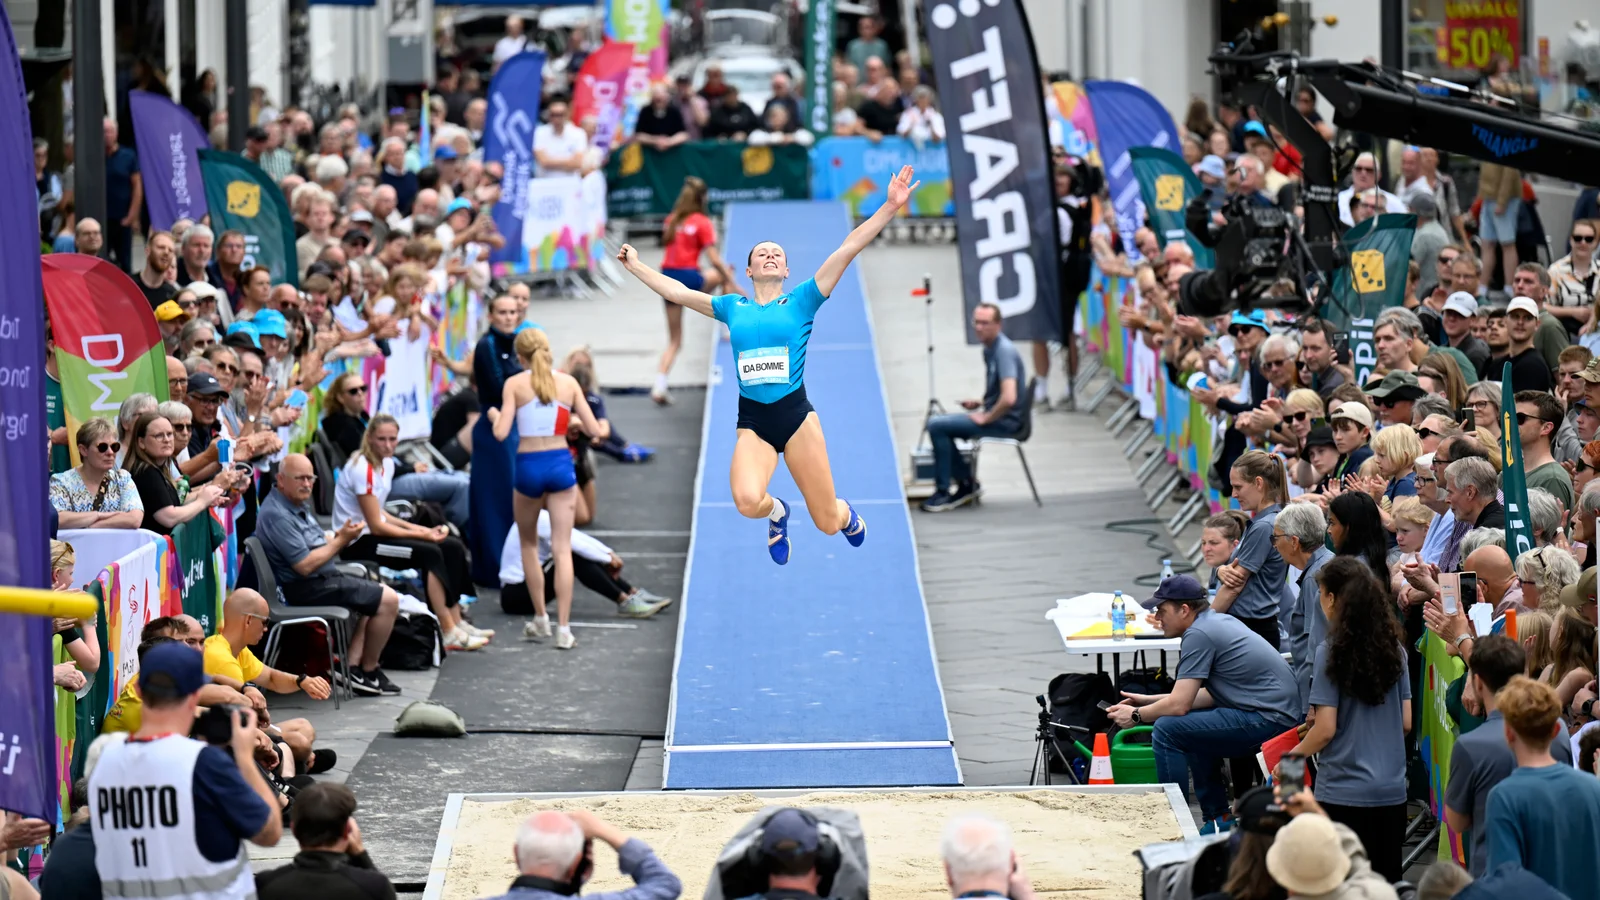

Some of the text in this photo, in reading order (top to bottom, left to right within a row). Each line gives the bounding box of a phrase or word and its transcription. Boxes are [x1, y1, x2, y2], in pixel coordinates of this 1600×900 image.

[1451, 27, 1514, 68] 50%
[1472, 123, 1539, 158] TRIANGLE
[743, 362, 784, 373] IDA BOMME
[98, 784, 179, 830] PHOTO
[131, 836, 148, 868] 11
